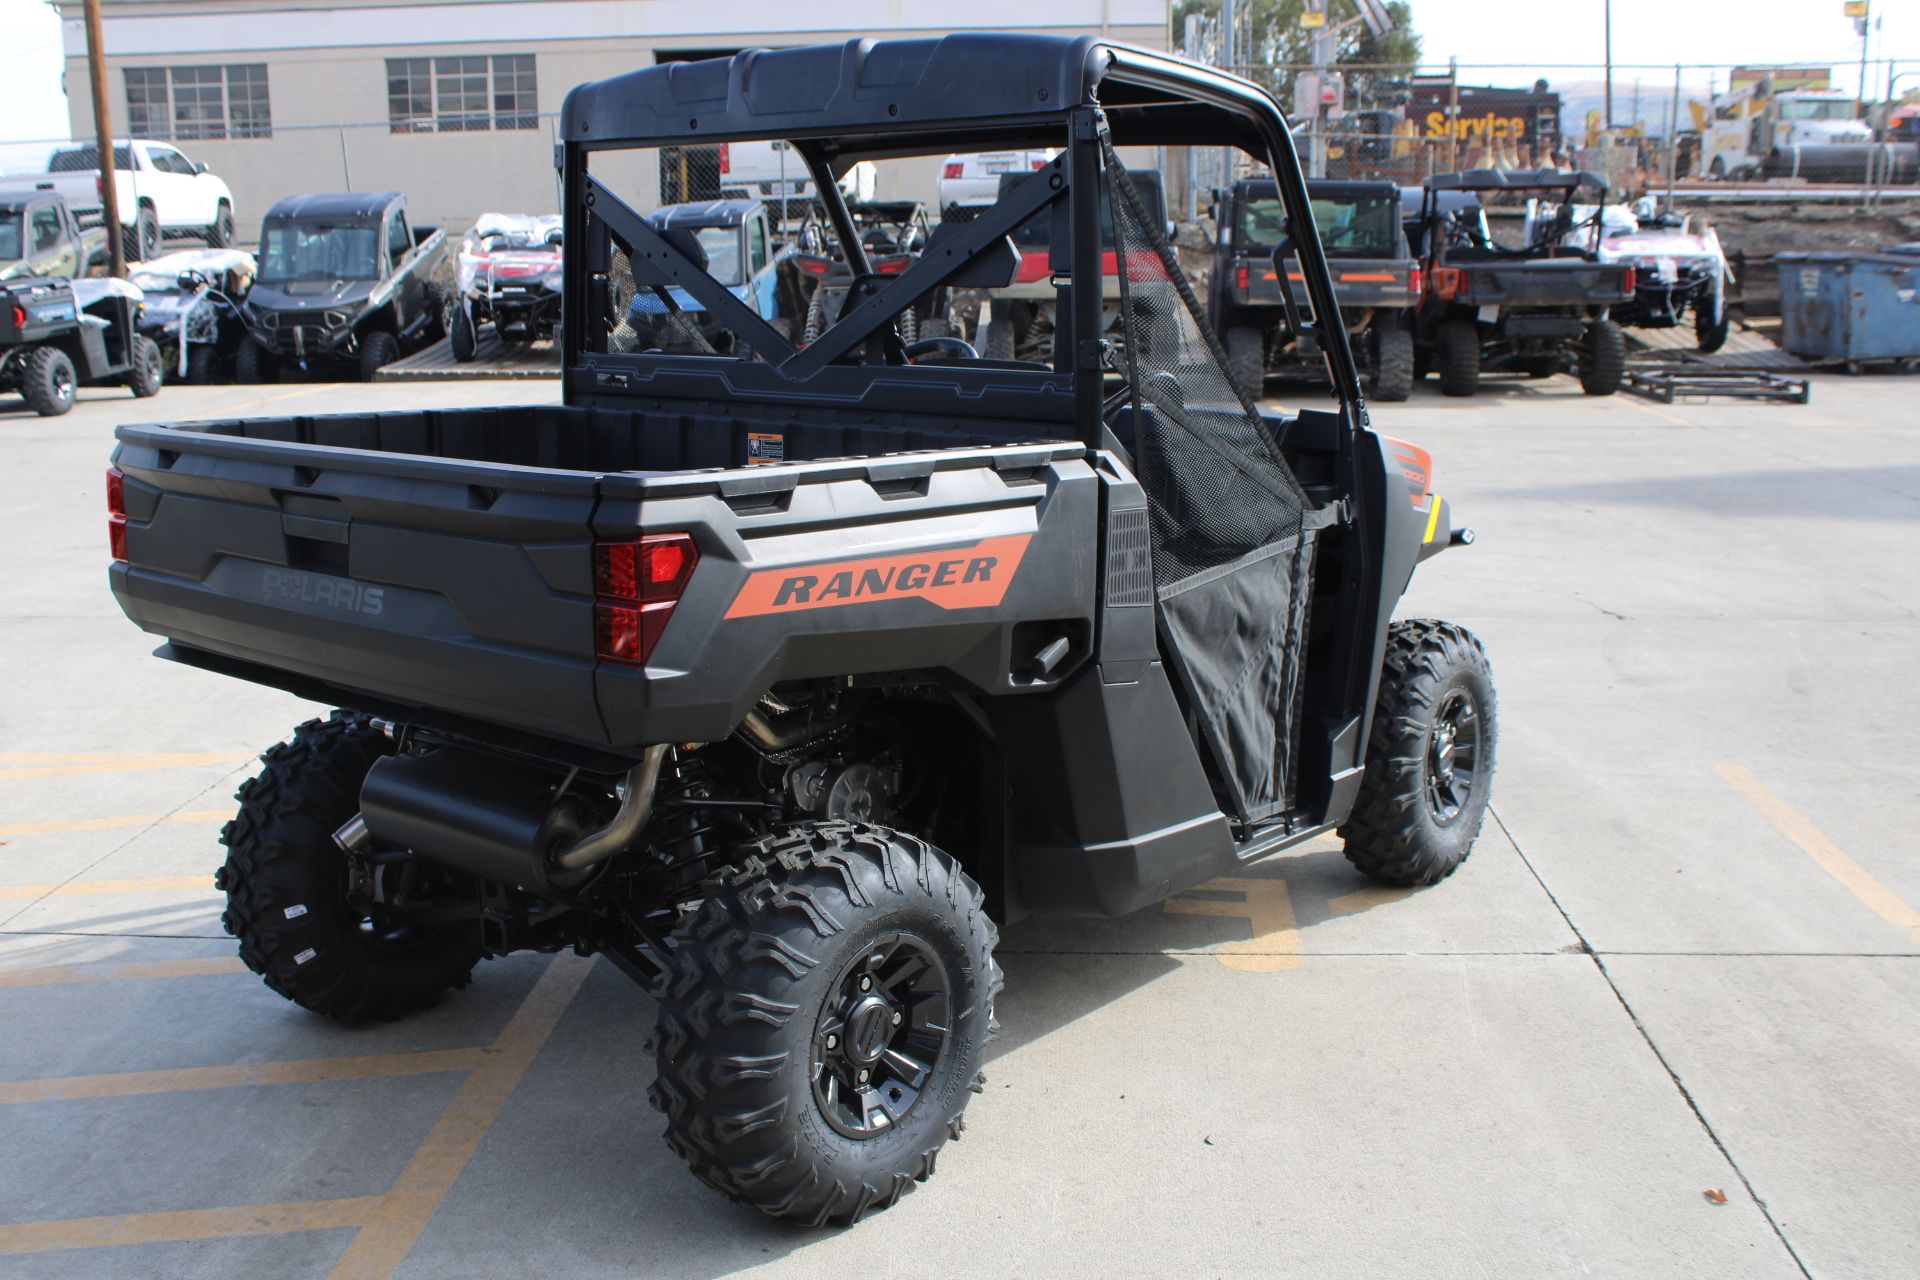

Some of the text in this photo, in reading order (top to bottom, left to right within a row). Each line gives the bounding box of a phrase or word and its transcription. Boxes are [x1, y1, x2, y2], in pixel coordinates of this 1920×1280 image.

[1426, 111, 1525, 140] Service
[262, 568, 384, 615] POLARIS
[772, 556, 998, 606] RANGER
